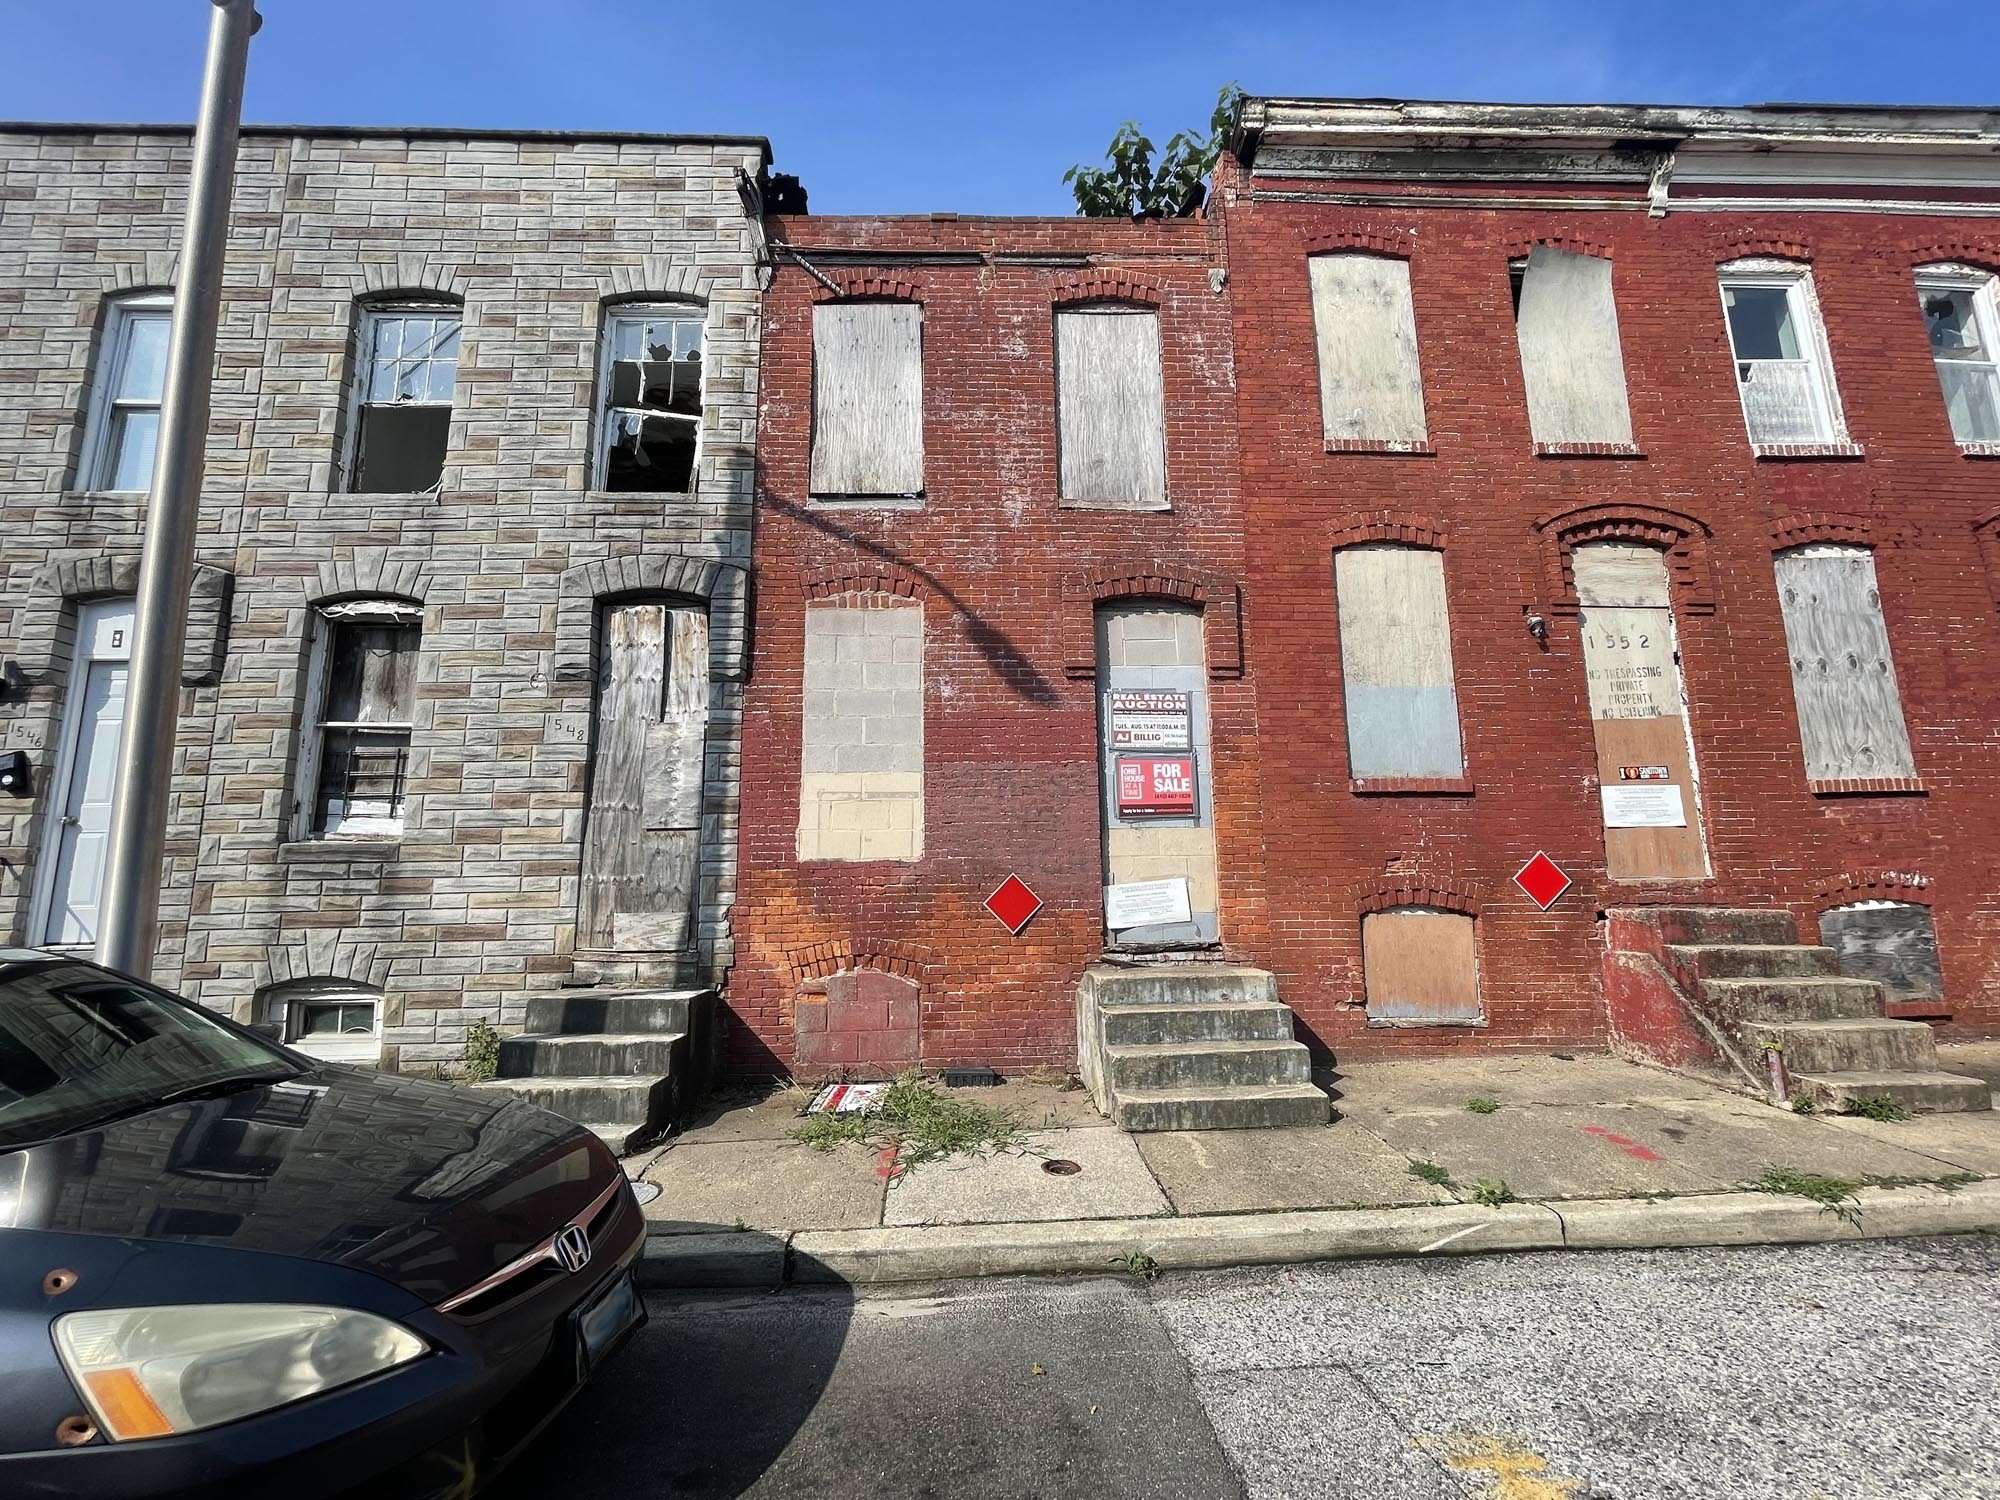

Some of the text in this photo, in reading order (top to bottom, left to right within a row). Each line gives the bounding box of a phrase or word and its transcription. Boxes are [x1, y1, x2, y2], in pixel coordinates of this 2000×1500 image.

[1588, 634, 1650, 649] 1552
[1604, 666, 1662, 680] TRESPASSING
[1610, 680, 1645, 692] PRIVATE
[1113, 701, 1186, 709] AUCTION
[1608, 692, 1653, 705] PROPERTY
[1602, 708, 1614, 719] NO
[11, 722, 42, 747] 1546
[547, 714, 584, 741] 1548
[1116, 732, 1130, 741] AJ
[1134, 733, 1161, 741] BILLIG
[1153, 763, 1182, 778] FOR
[1154, 778, 1191, 793] SALE
